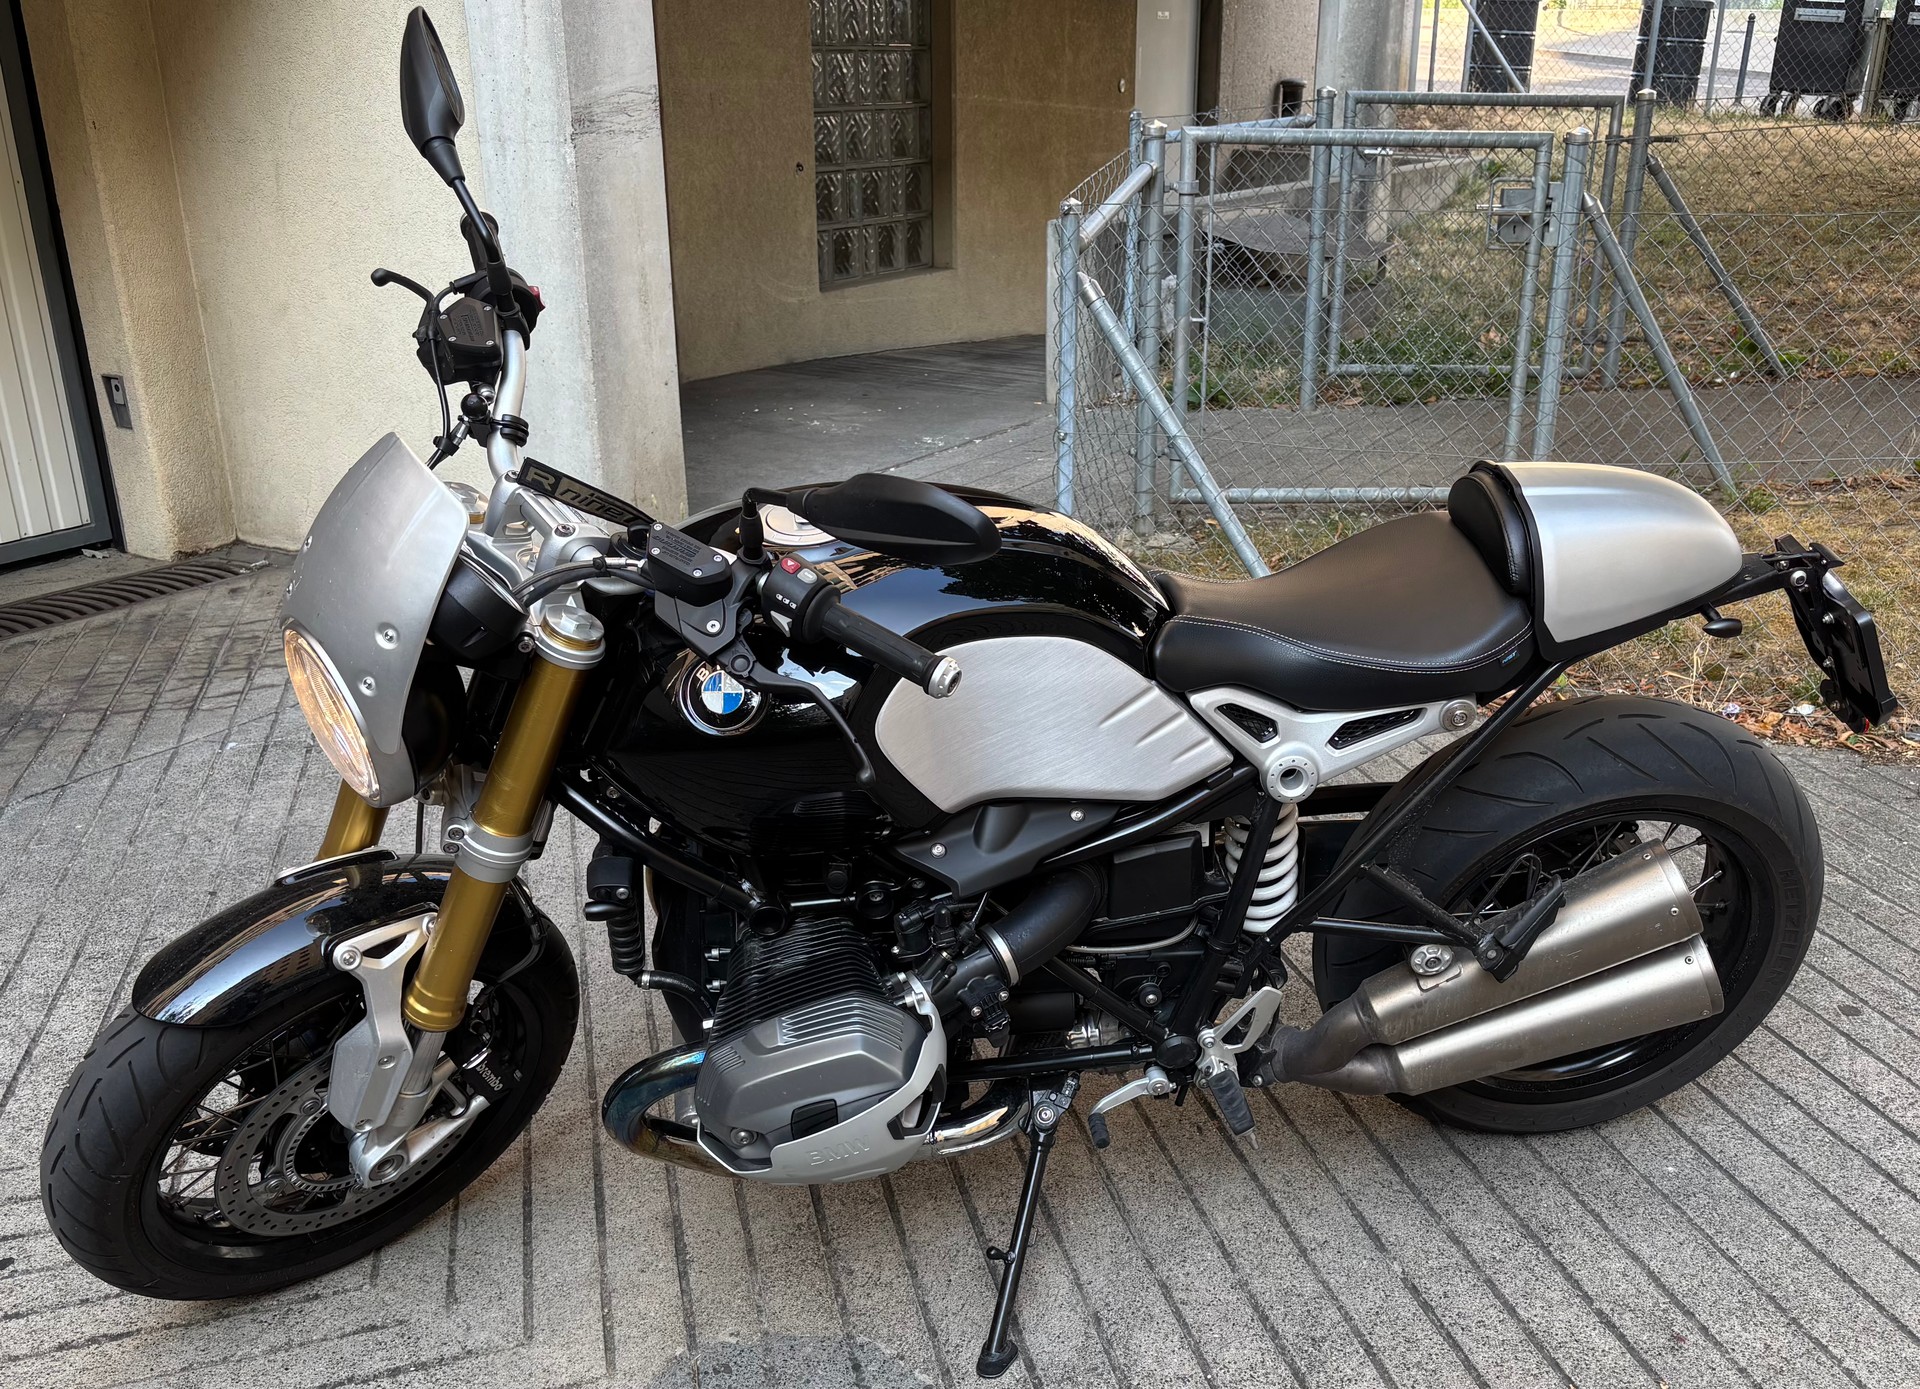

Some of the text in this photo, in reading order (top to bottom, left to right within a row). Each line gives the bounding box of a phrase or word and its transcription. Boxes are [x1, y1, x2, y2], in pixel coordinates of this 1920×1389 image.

[525, 466, 556, 492] R
[475, 1060, 504, 1091] brembo
[808, 1134, 871, 1166] BMW
